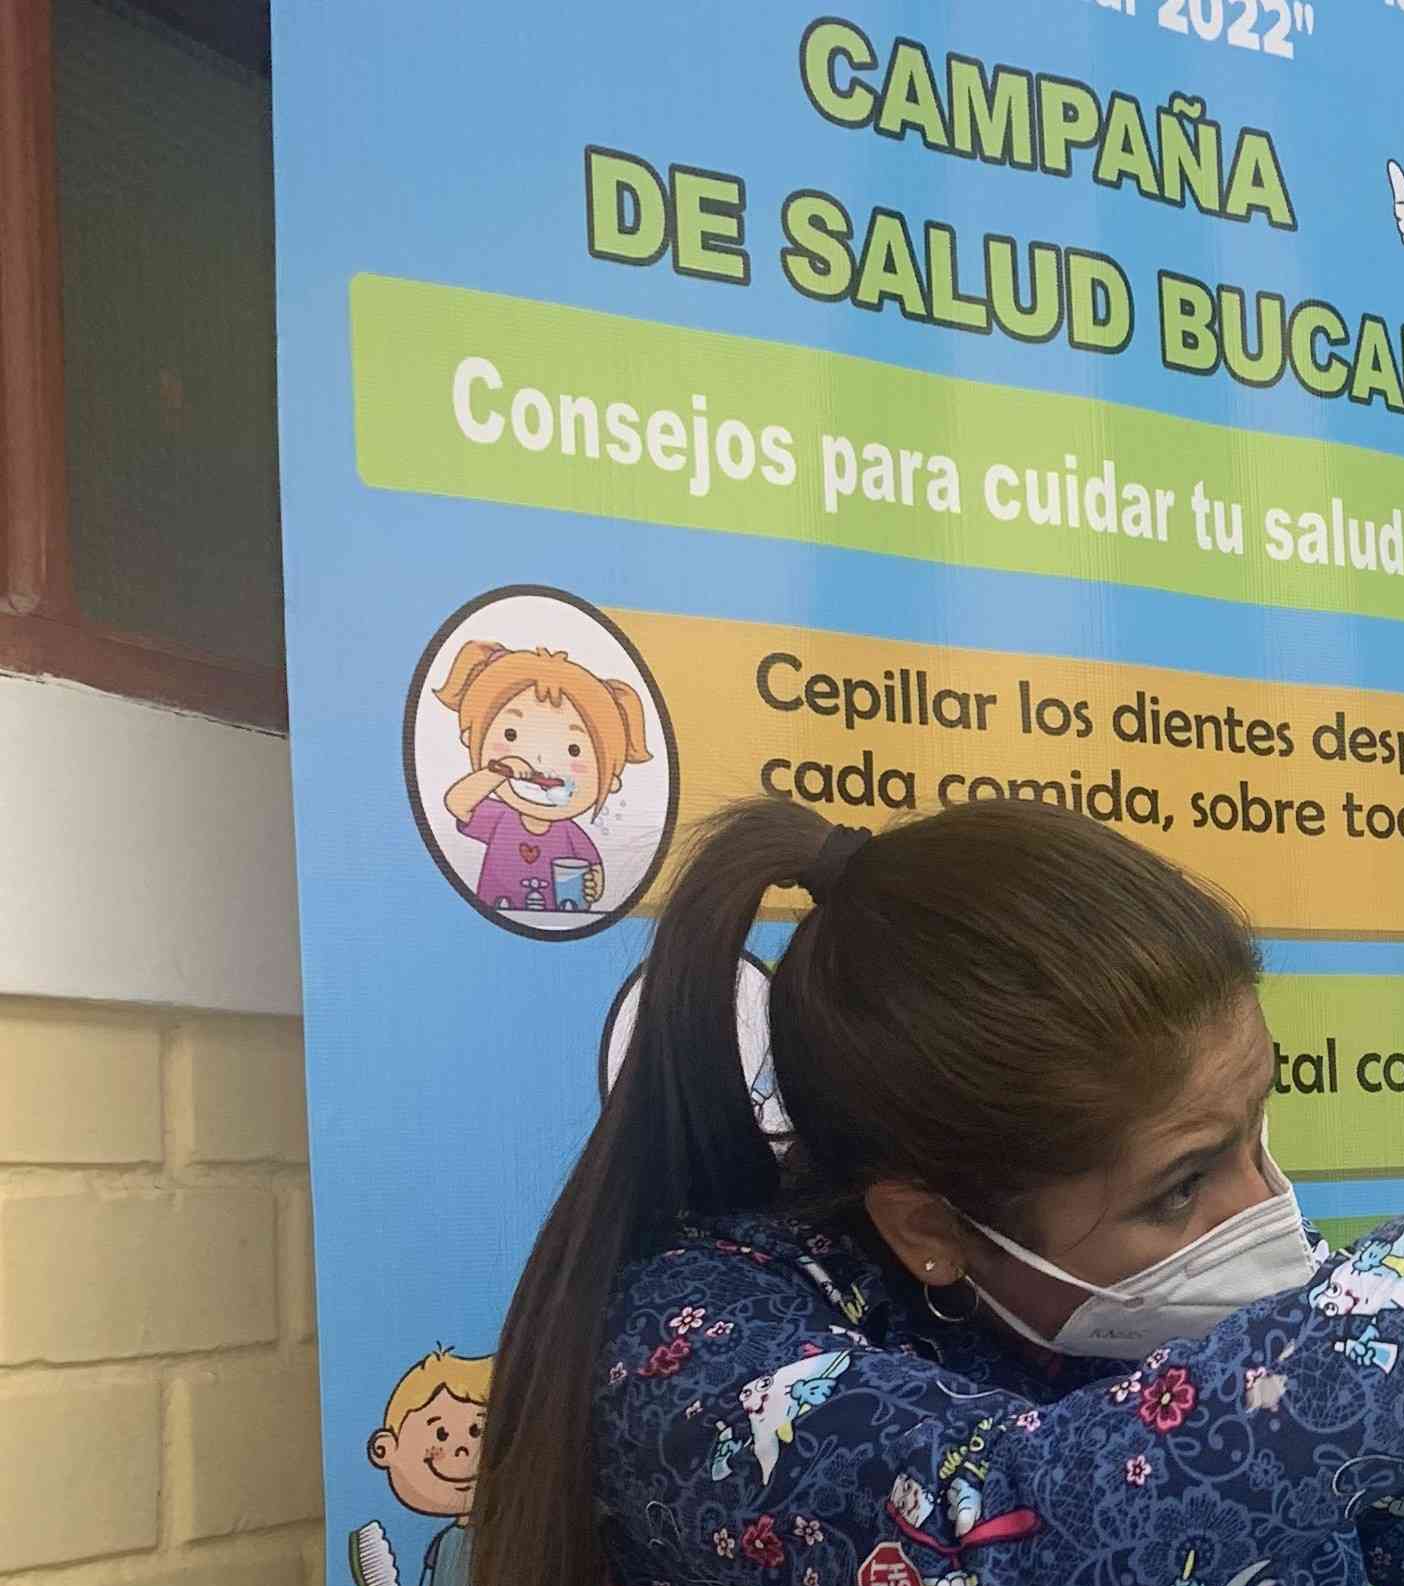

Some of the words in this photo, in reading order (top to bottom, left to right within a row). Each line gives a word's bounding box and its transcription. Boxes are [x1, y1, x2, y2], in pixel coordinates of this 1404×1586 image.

[800, 16, 1297, 231] CAMPAÑA
[584, 145, 750, 286] DE
[781, 189, 1134, 354] SALUD
[452, 356, 797, 497] Consejos
[822, 432, 961, 513] para
[984, 453, 1174, 541] cuidar
[1192, 480, 1244, 555] tu
[1264, 497, 1404, 576] salud
[756, 652, 997, 731] Cepillar
[1019, 680, 1093, 738] los
[1113, 691, 1294, 757] dientes
[760, 751, 916, 809] cada
[1191, 781, 1326, 836] sobre
[1273, 1037, 1338, 1094] tal
